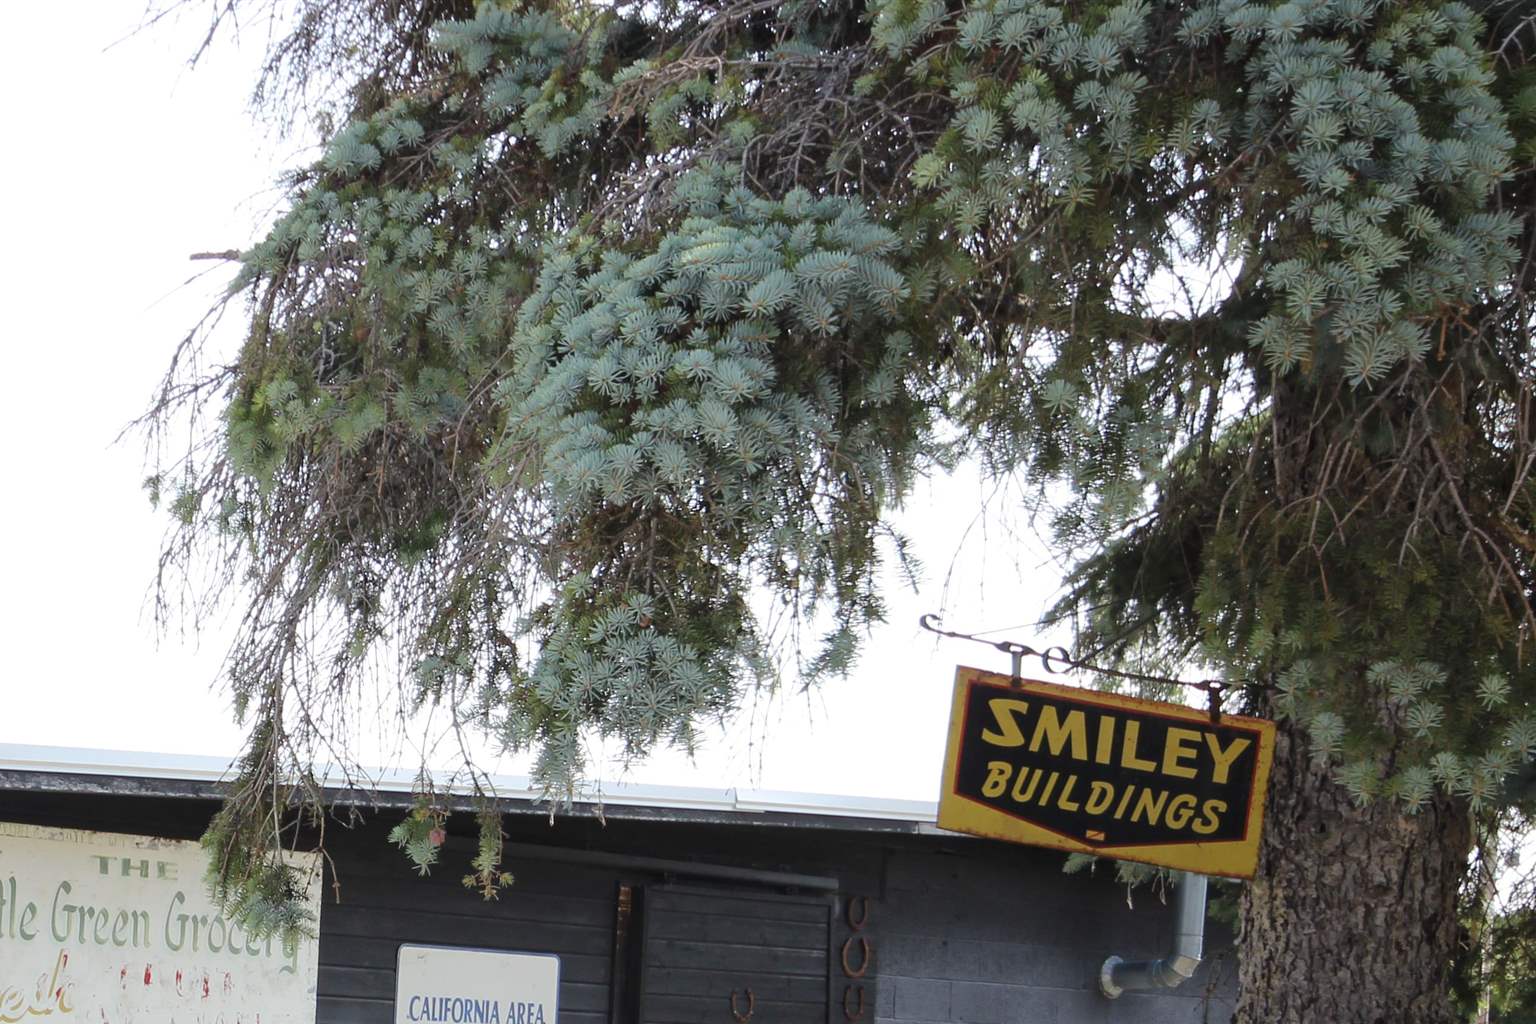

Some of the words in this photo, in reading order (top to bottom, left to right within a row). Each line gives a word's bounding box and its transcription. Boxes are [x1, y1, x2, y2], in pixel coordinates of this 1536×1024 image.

[980, 697, 1252, 785] SMILEY
[980, 760, 1228, 835] BUILDINGS
[90, 854, 180, 881] THE
[50, 880, 152, 949] Green
[409, 995, 501, 1024] CALIFORNIA
